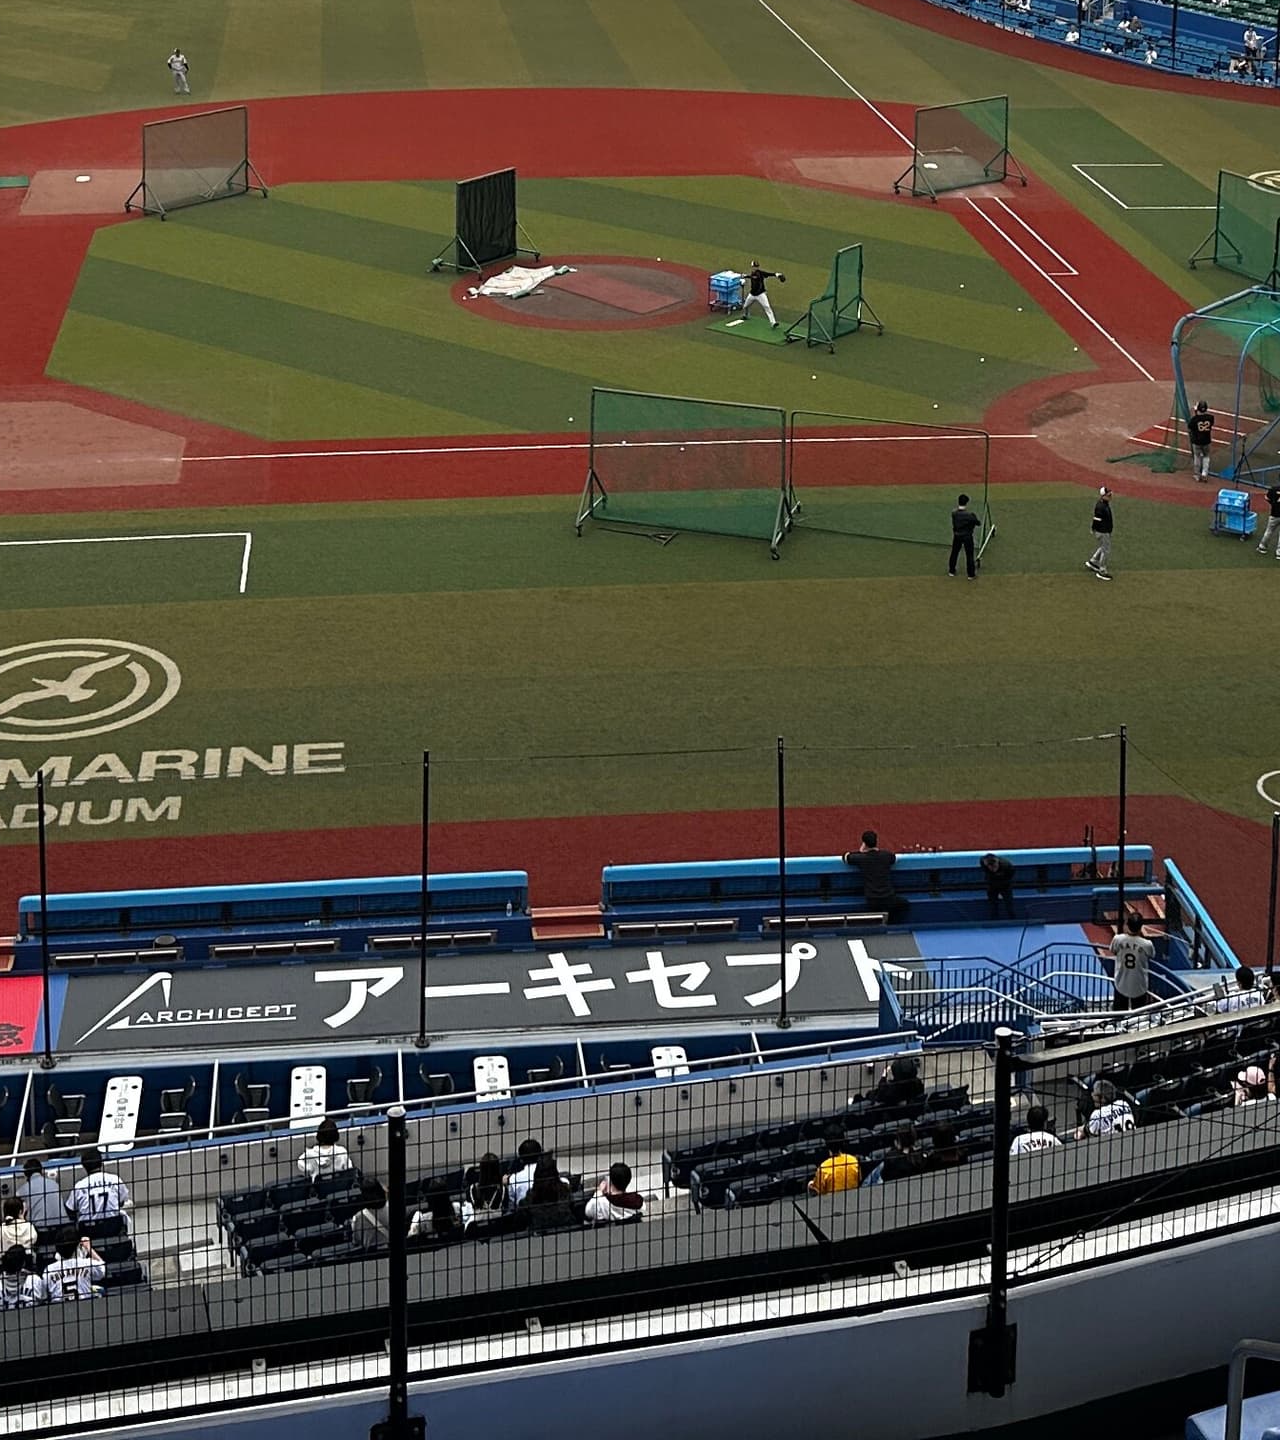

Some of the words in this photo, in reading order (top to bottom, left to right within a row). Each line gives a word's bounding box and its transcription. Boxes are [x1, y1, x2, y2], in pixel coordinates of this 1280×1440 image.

[1197, 421, 1211, 432] 62
[1124, 953, 1136, 970] 8
[314, 937, 916, 1028] アーキセプト
[135, 1002, 297, 1022] ARCHICEPT
[89, 1192, 110, 1215] 17
